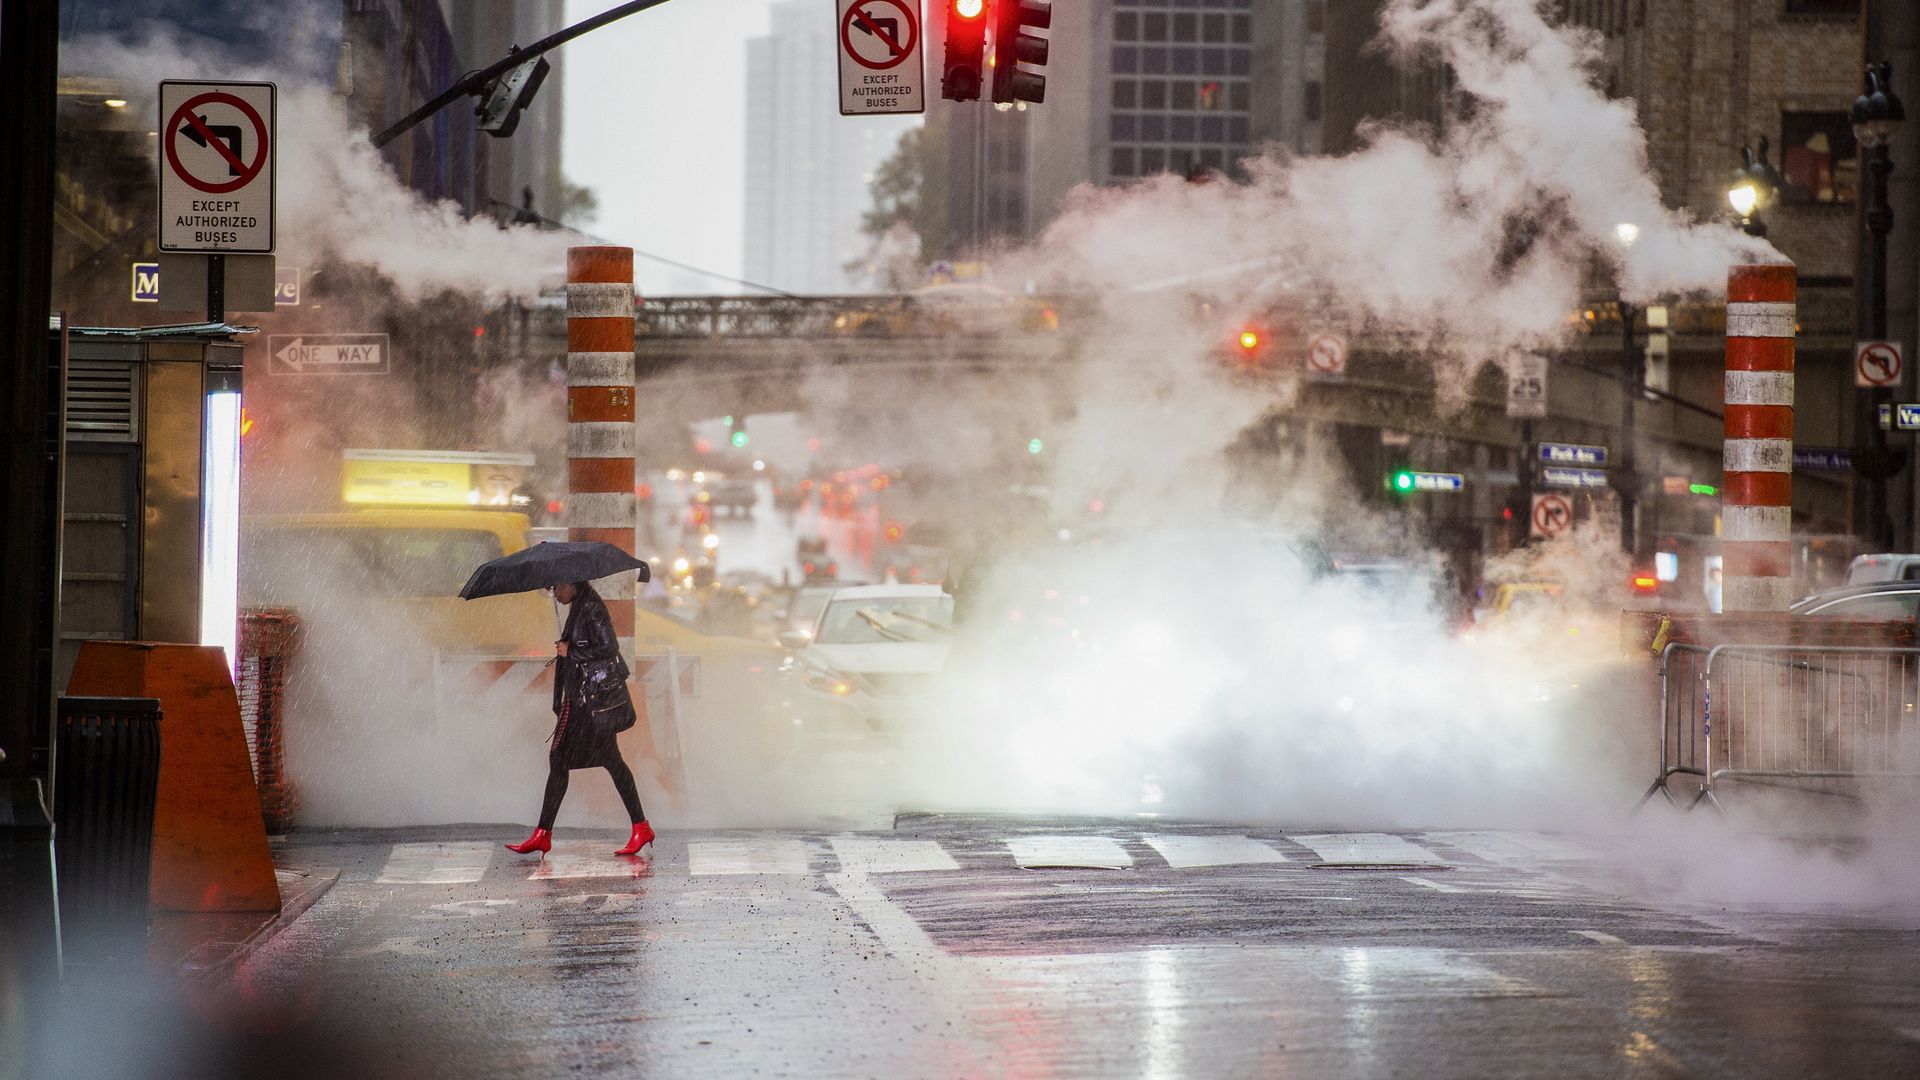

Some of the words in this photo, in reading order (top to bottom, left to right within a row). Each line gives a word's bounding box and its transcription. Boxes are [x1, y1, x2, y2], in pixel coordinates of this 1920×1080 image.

[863, 75, 899, 84] EXCEPT
[852, 86, 912, 96] AUTHORIZED
[866, 98, 898, 107] BUSES
[192, 200, 240, 212] EXCEPT
[176, 216, 257, 228] AUTHORIZED
[195, 231, 237, 242] BUSES
[287, 347, 321, 362] ONE
[336, 347, 374, 361] WAY
[1513, 377, 1541, 399] 25
[1550, 446, 1574, 461] Park
